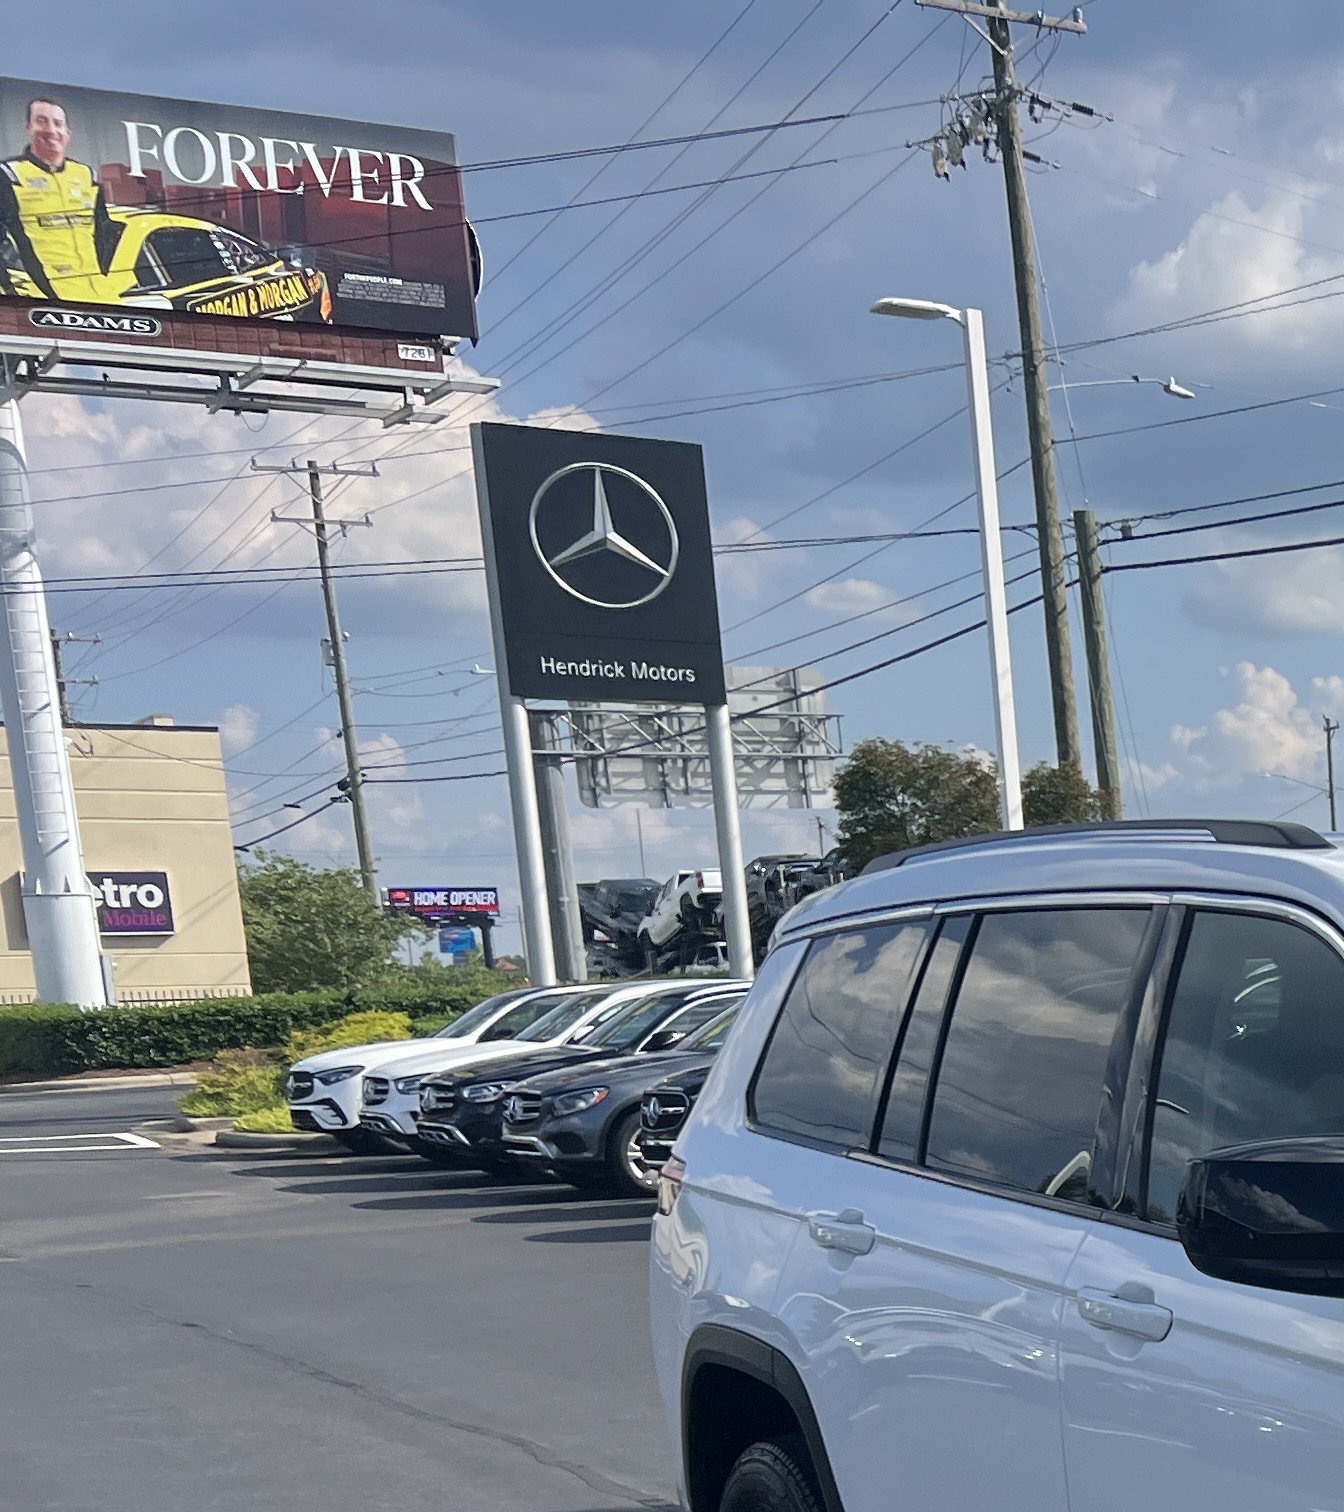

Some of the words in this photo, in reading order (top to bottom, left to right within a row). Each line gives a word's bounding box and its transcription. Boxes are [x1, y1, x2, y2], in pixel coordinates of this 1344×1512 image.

[121, 120, 434, 211] FOREVER
[248, 288, 259, 316] &
[256, 275, 309, 312] MORGAN
[40, 313, 151, 333] ADAMS
[541, 657, 626, 679] Hendrick
[631, 662, 696, 683] Motors
[414, 891, 449, 906] HOME
[449, 891, 496, 906] OPENER
